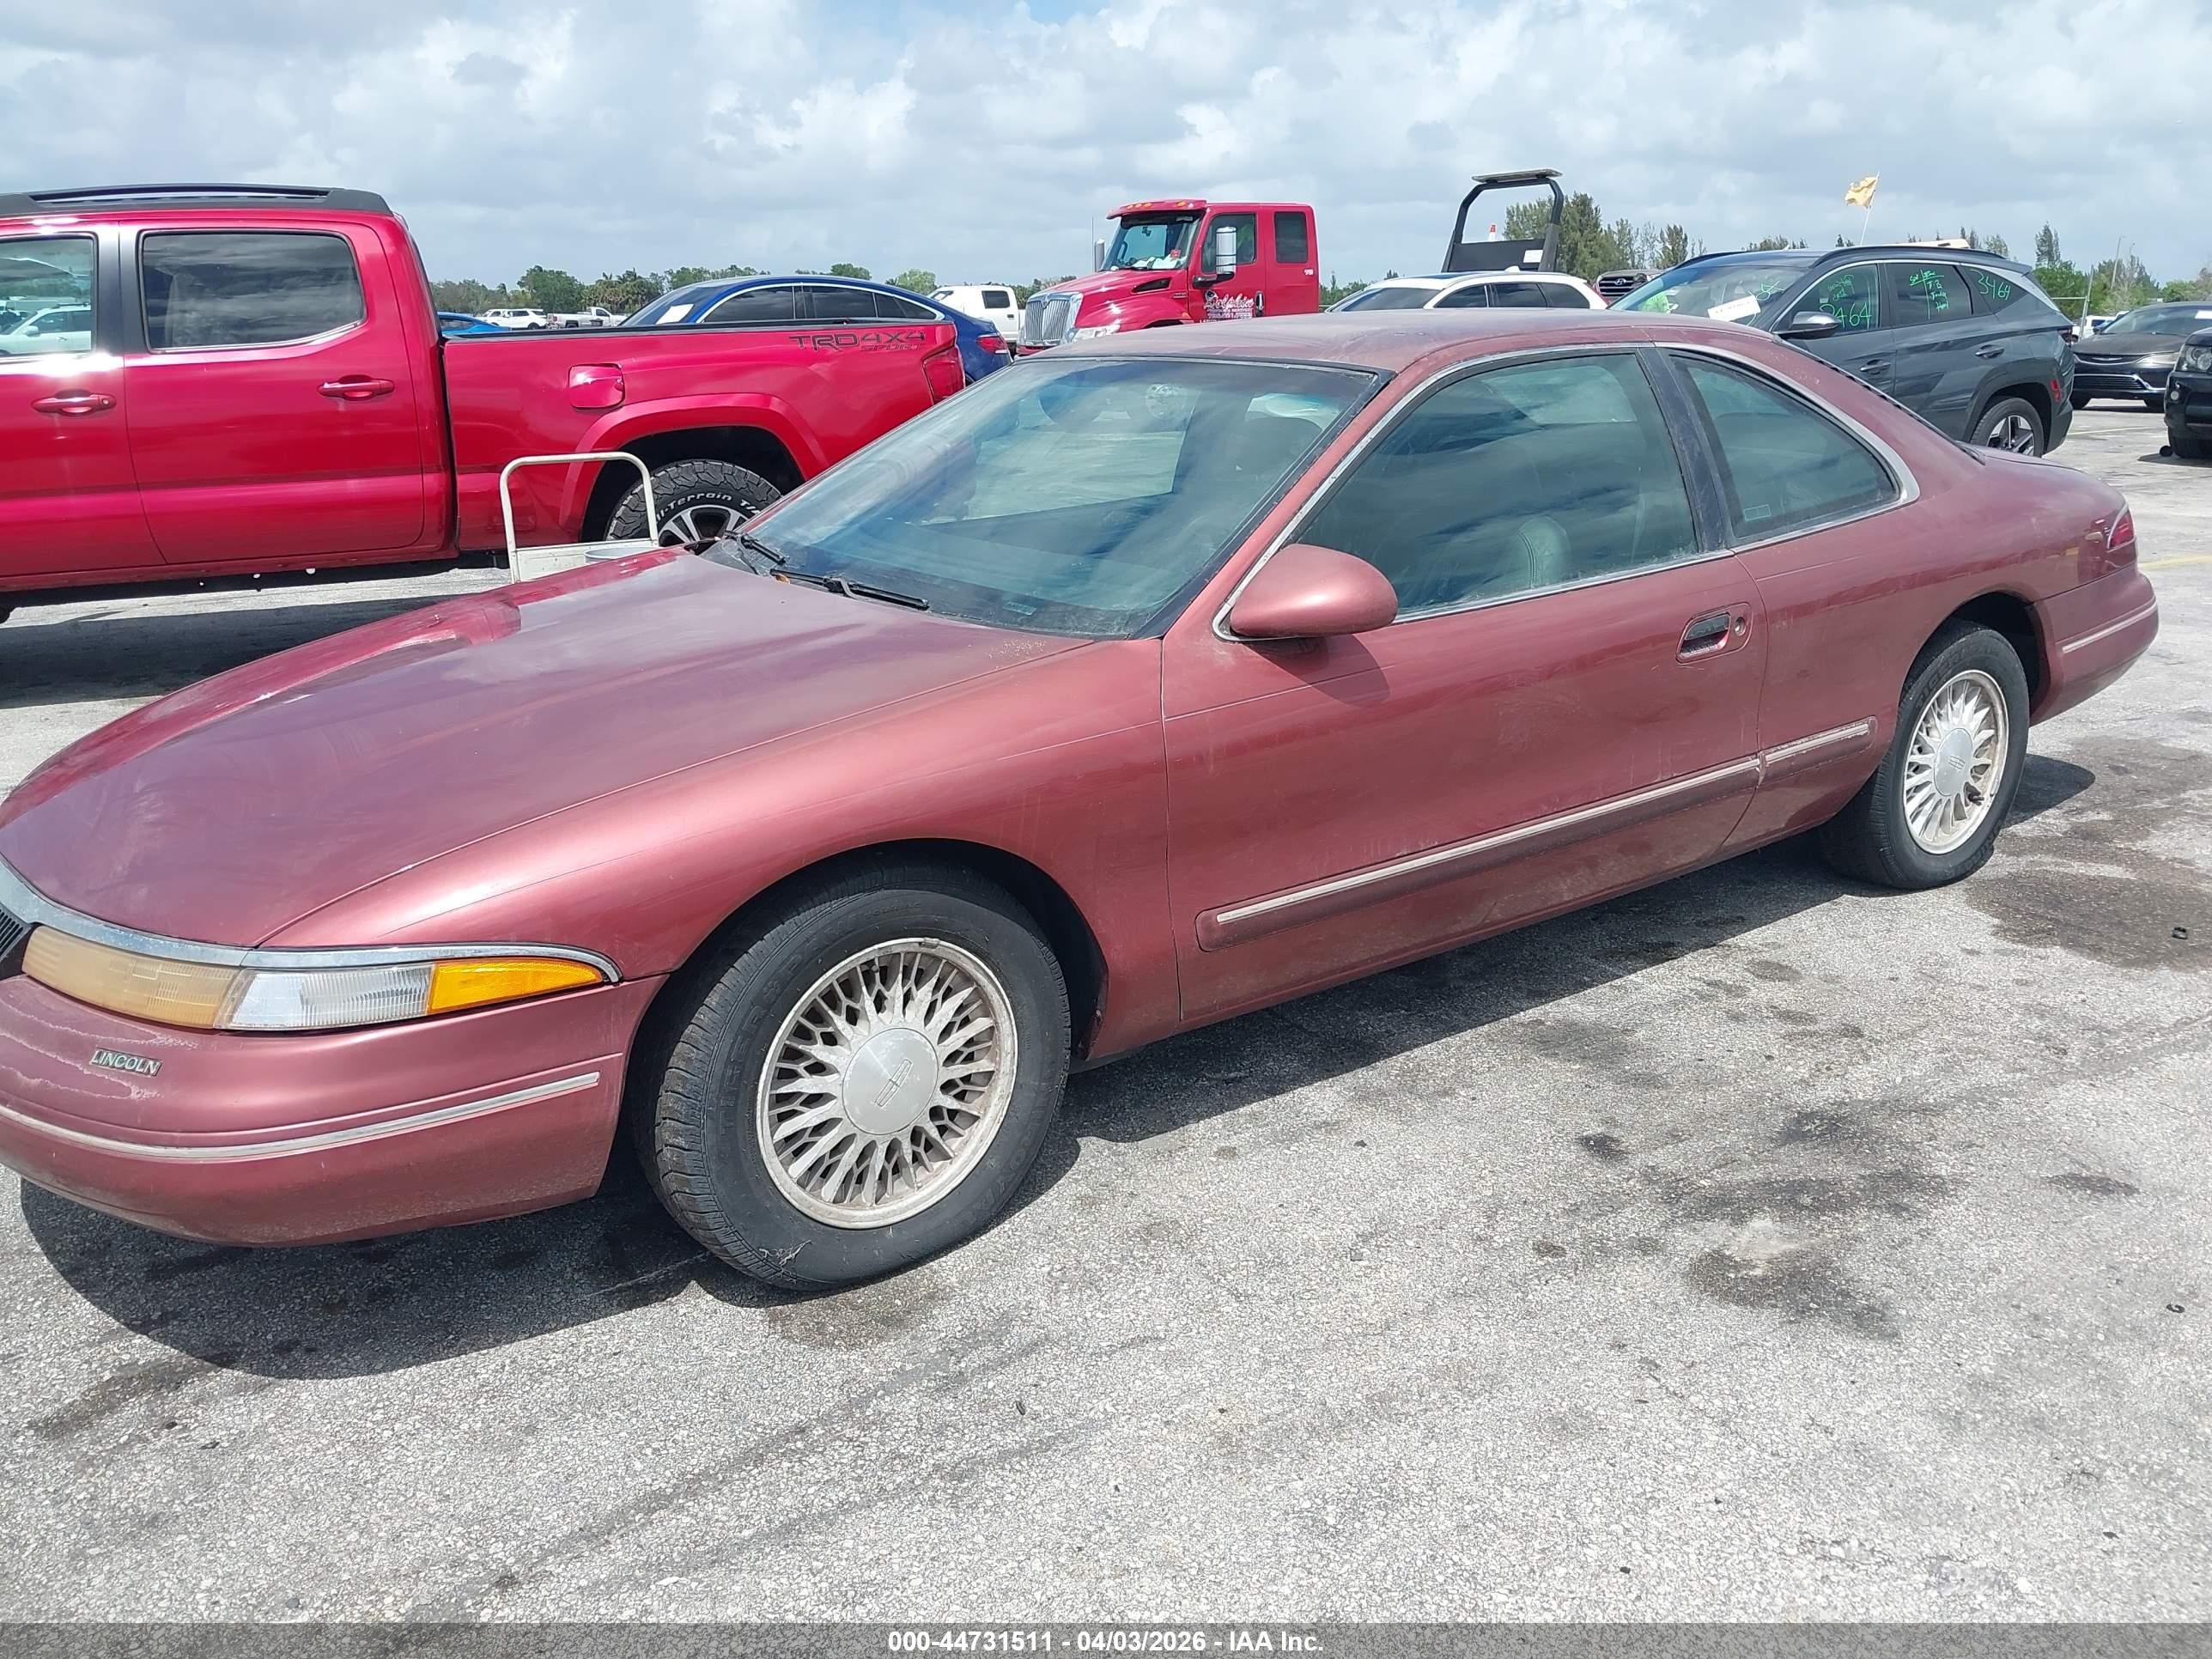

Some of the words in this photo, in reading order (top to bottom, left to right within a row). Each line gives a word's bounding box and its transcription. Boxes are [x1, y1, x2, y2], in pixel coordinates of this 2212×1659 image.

[1971, 269, 2011, 301] 3464
[788, 333, 860, 352] TRD
[861, 343, 921, 351] SPORT
[88, 1048, 162, 1075] LINCOLN
